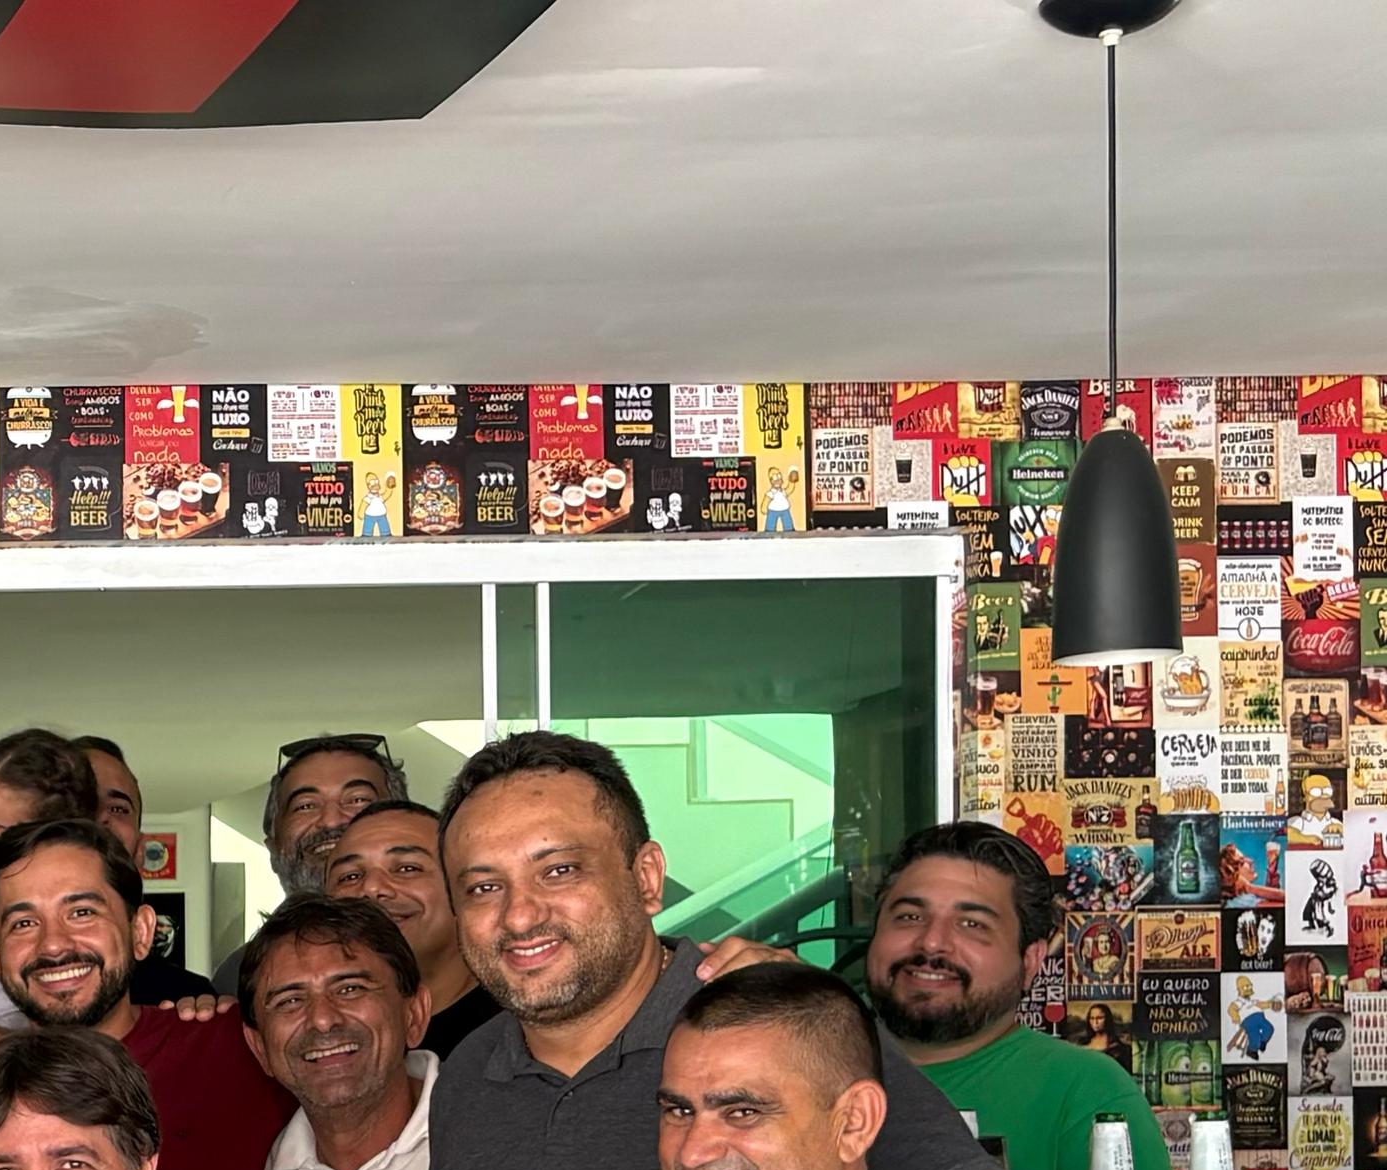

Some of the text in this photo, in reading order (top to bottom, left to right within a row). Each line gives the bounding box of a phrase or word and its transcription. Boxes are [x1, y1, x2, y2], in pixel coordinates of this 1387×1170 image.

[212, 388, 250, 403] NÃO
[614, 384, 652, 399] NÃO
[212, 413, 250, 425] LUXO
[614, 408, 653, 421] LUXO
[1012, 468, 1064, 479] Heineken
[1171, 486, 1200, 496] KEEP
[1171, 498, 1201, 507] CALM
[70, 510, 108, 526] BEER
[307, 508, 344, 527] VIVER
[477, 506, 514, 521] BEER
[1235, 606, 1264, 617] HOJE
[1012, 749, 1058, 759] VINHO
[1012, 775, 1057, 793] RUM
[1163, 978, 1209, 990] QUERO
